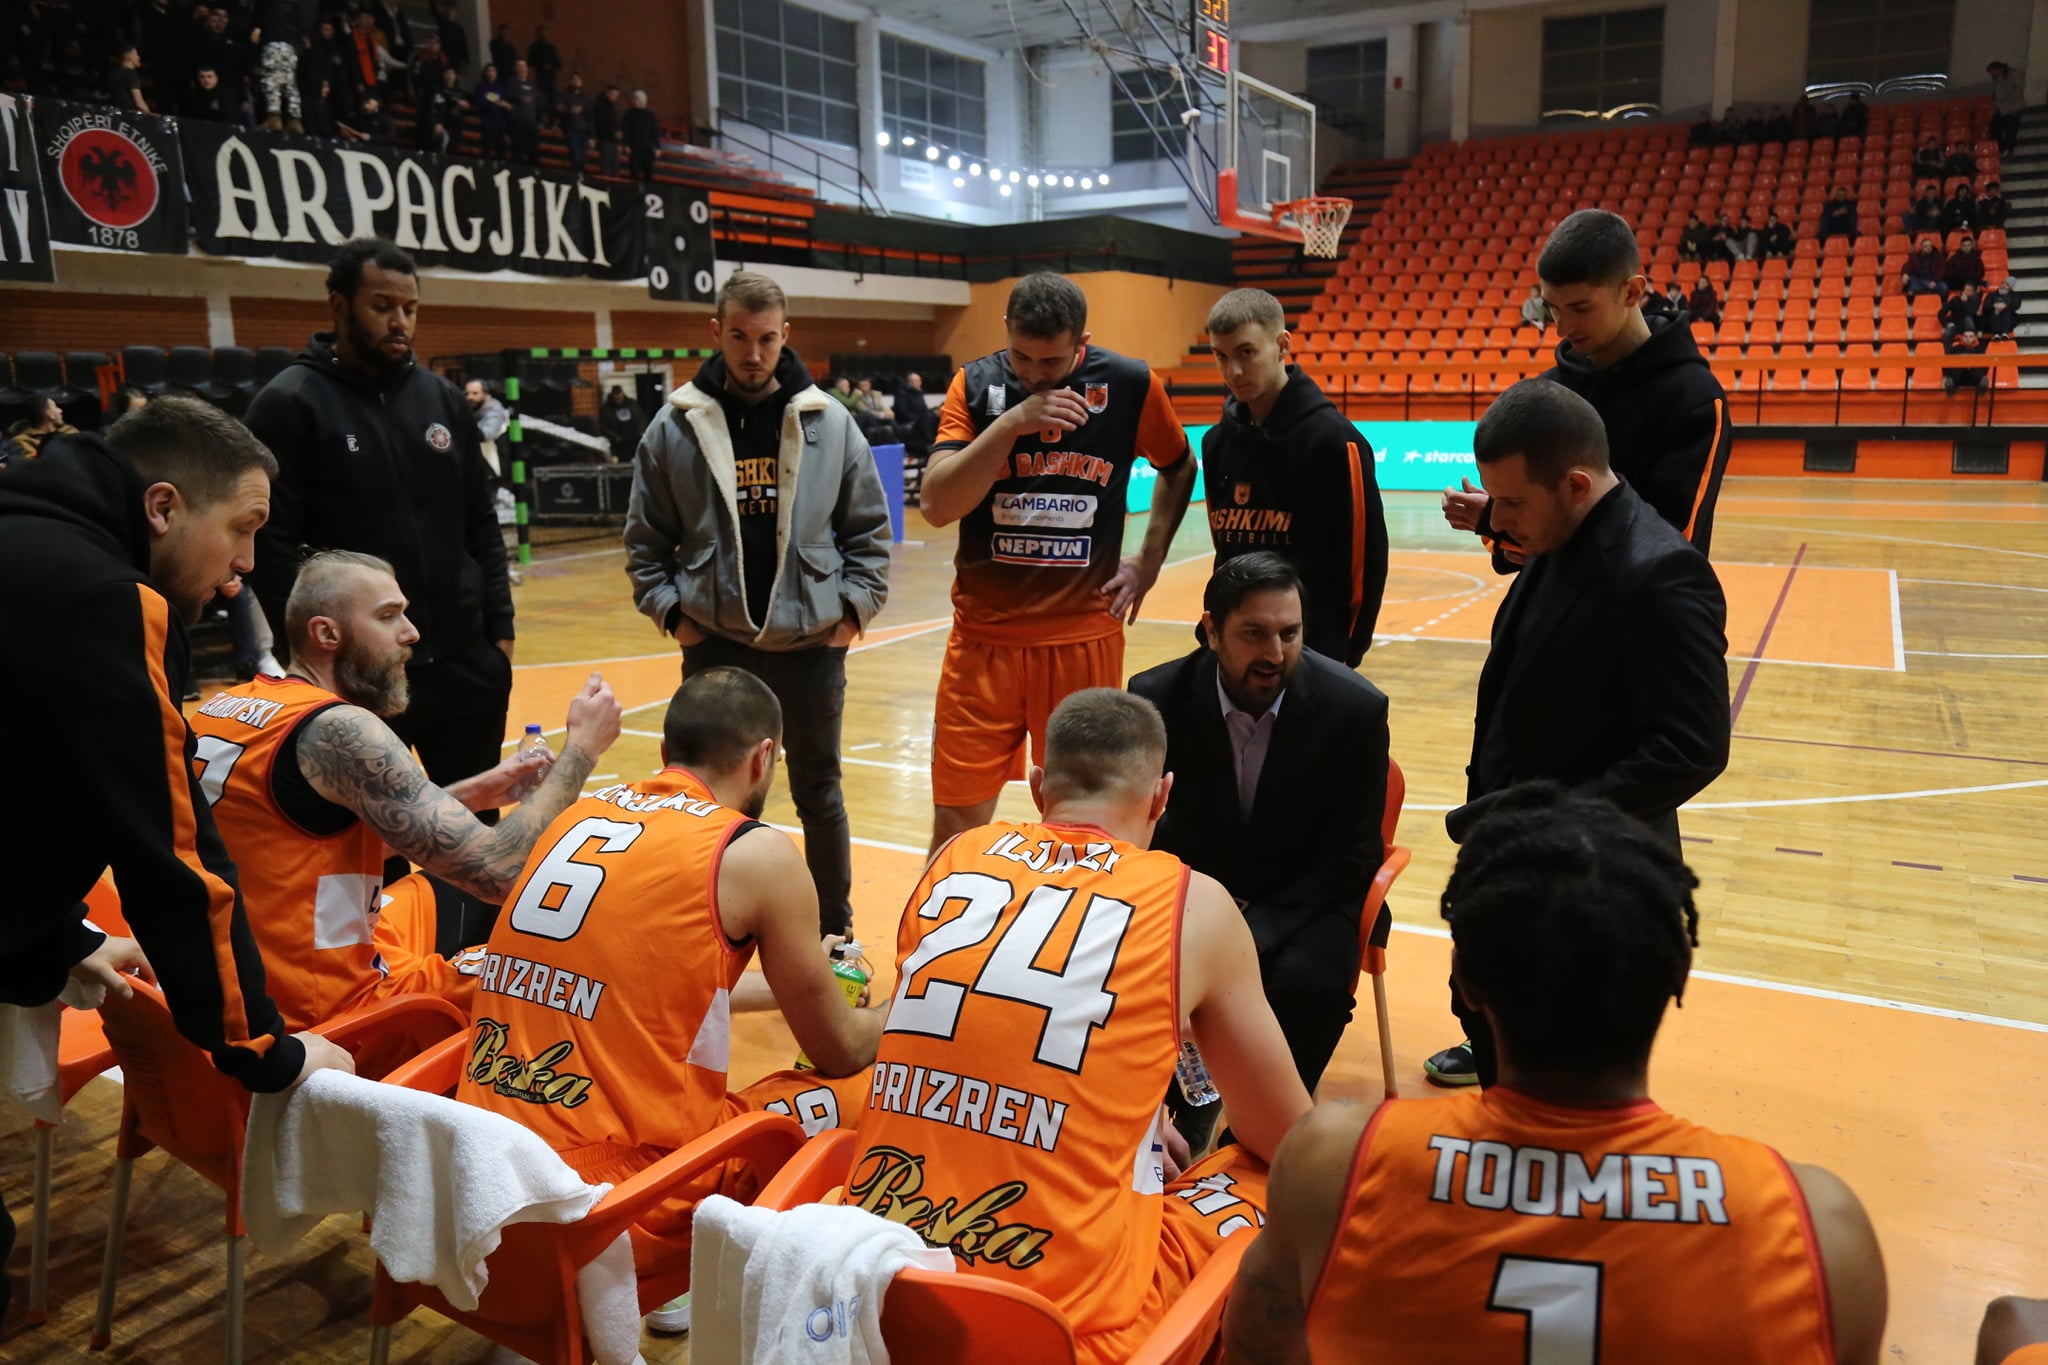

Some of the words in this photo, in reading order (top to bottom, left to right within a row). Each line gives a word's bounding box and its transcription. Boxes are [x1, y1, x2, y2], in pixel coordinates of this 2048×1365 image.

[1206, 30, 1229, 73] 37
[118, 121, 168, 176] ETNIKE
[214, 135, 611, 268] ARPAGJIKT
[88, 226, 140, 249] 1878
[1424, 450, 1477, 464] starca
[1001, 497, 1088, 513] LAMBARIO
[998, 538, 1083, 557] NEPTUN
[509, 816, 645, 942] 6
[983, 832, 1124, 874] ILJAZI
[883, 872, 1137, 1076] 24
[869, 1060, 1070, 1153] PRIZREN
[1427, 1133, 1731, 1226] TOOMER
[1484, 1252, 1605, 1365] 1
